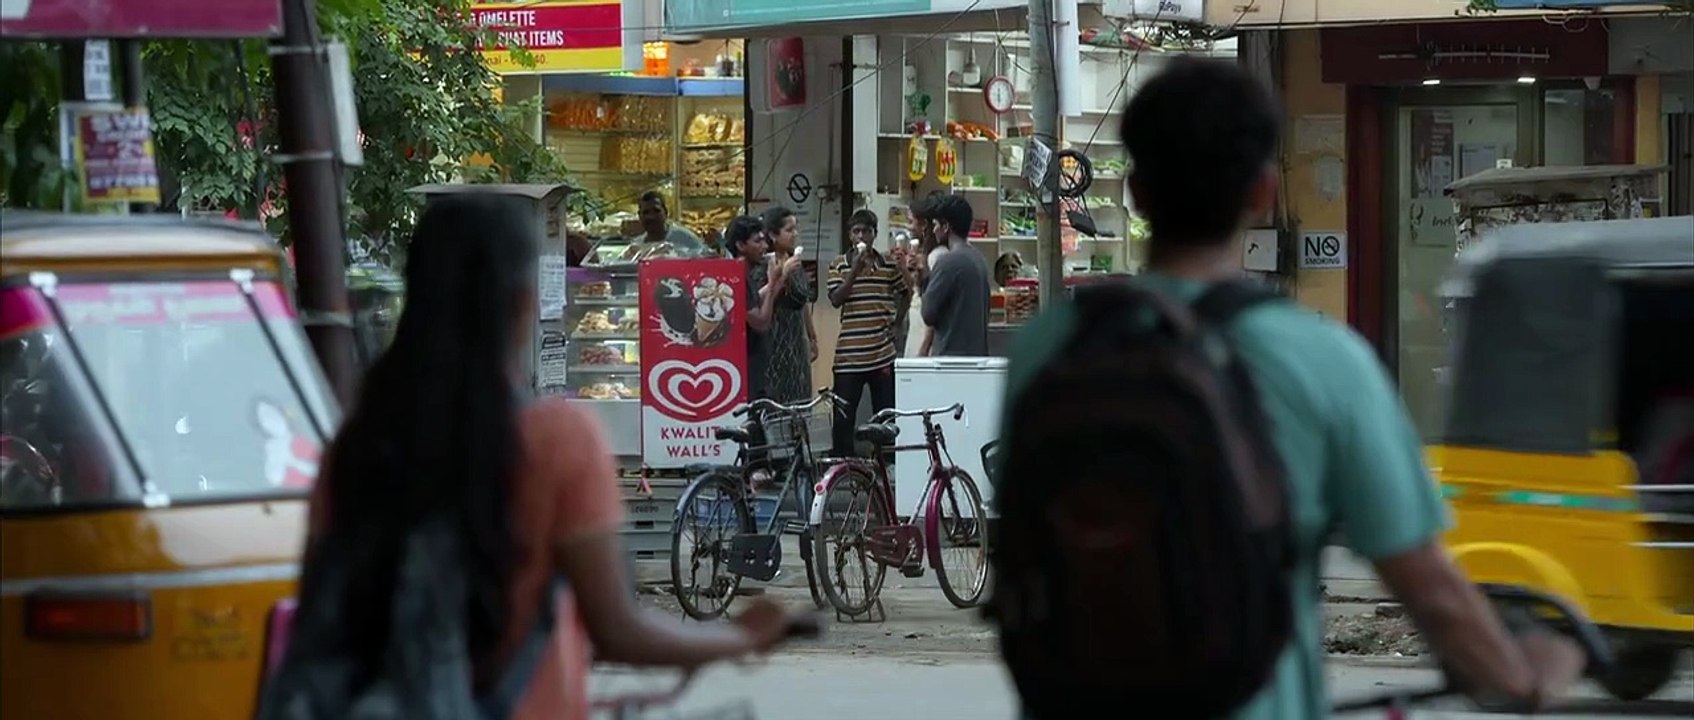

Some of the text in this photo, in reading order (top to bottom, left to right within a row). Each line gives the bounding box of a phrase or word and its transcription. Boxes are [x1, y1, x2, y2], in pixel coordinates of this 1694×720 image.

[478, 10, 536, 28] OMELETTE
[529, 29, 564, 46] ITEMS
[1305, 236, 1340, 256] NO
[661, 425, 721, 440] KWALIT
[667, 444, 721, 457] WALL'S
